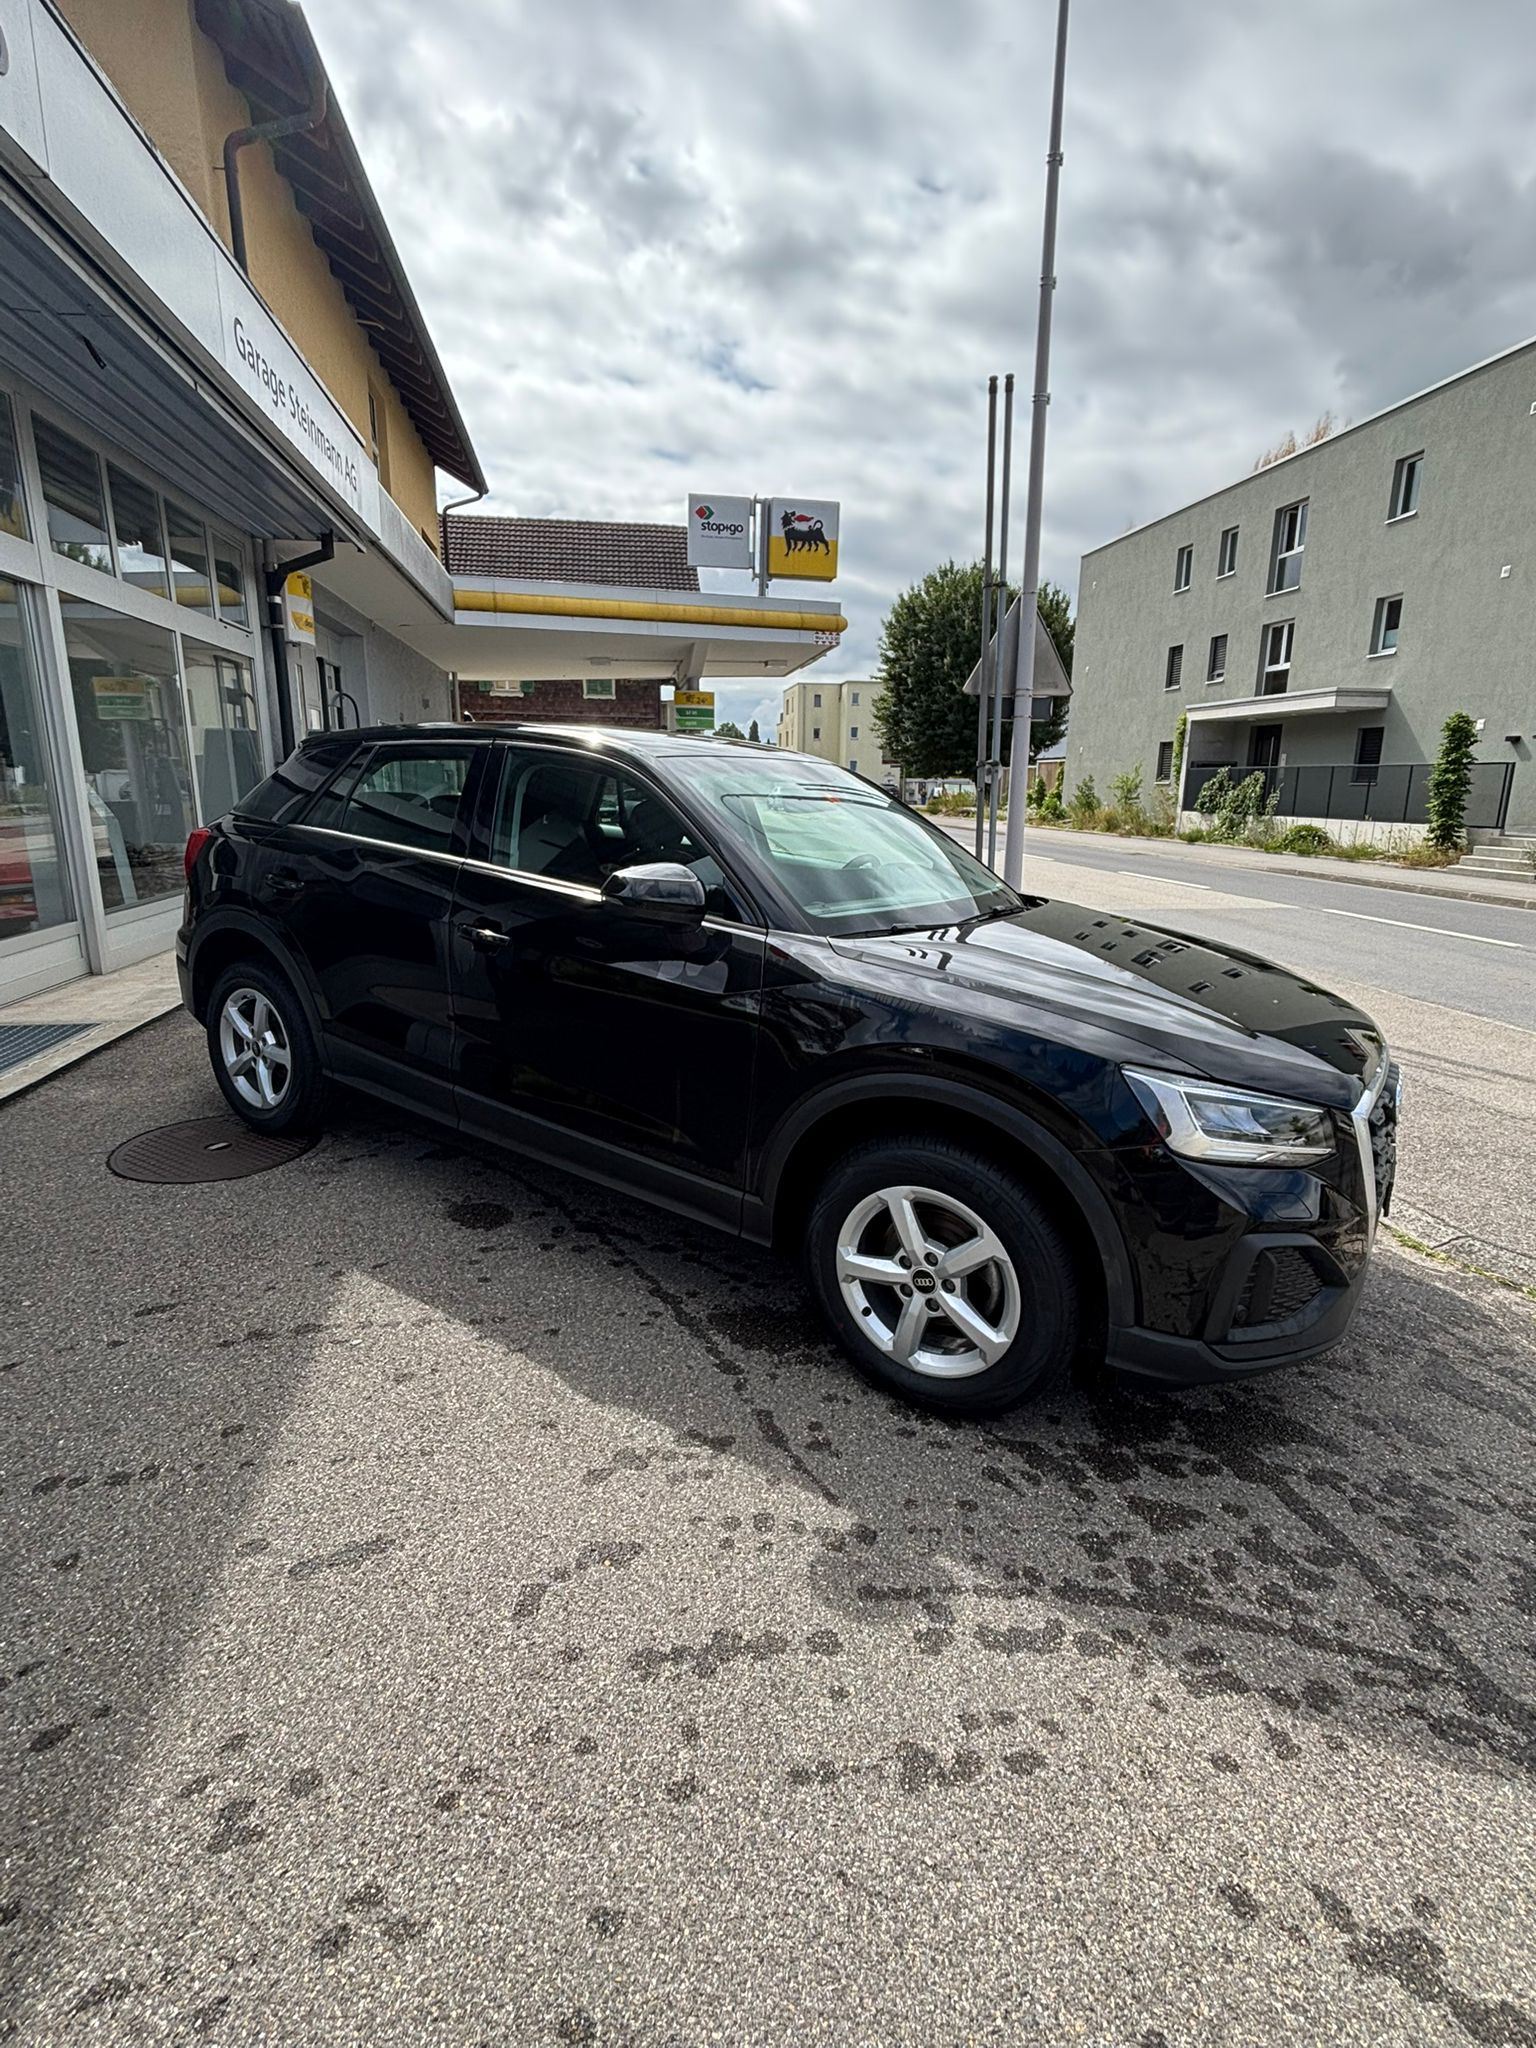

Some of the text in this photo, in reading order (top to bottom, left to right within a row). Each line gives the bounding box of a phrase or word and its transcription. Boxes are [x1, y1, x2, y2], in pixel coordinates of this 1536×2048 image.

[233, 316, 358, 492] Garage Steinmann AG
[701, 520, 744, 536] stop+go
